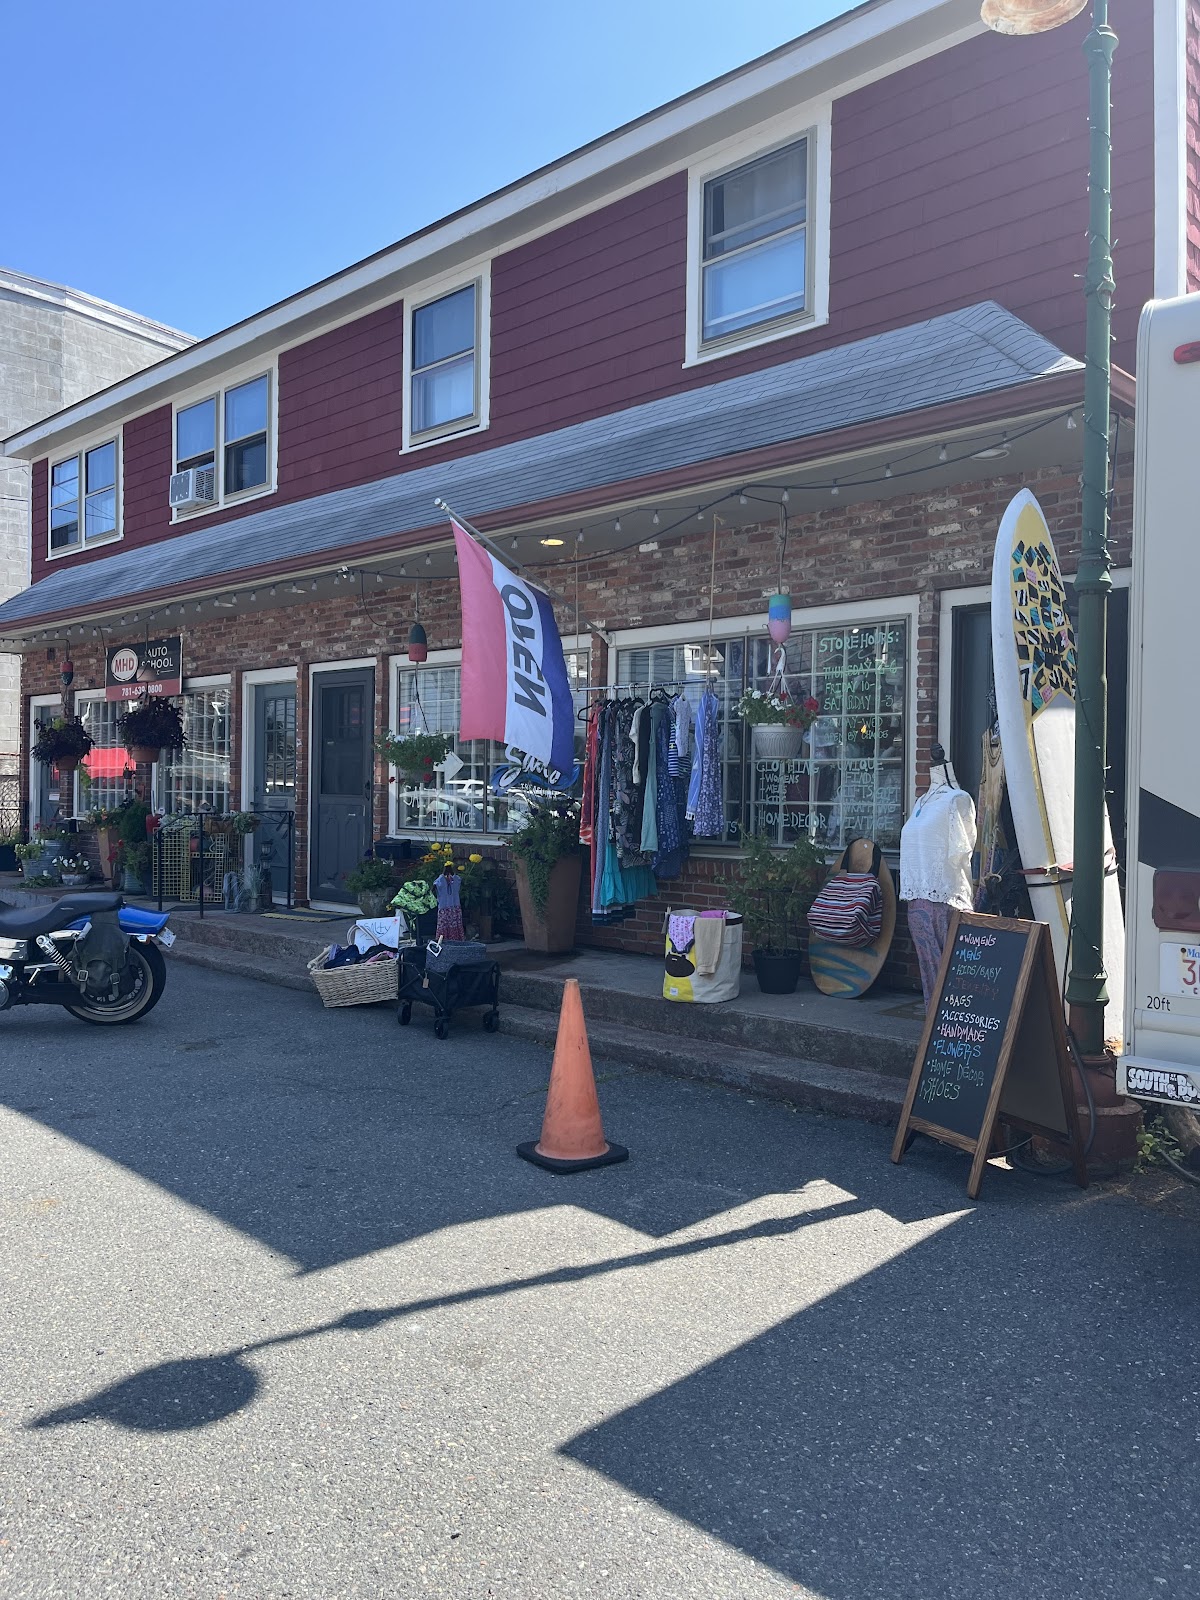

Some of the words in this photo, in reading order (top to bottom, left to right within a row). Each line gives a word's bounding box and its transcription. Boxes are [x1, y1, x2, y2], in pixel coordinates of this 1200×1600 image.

[501, 584, 546, 717] OPEN
[819, 636, 858, 653] STORE
[860, 631, 899, 649] HOURS:
[147, 646, 168, 658] AUTO
[115, 657, 134, 673] MHD
[823, 661, 873, 680] THURSDAY
[825, 682, 858, 695] FRIDAY
[823, 694, 872, 711] SATRDAY
[847, 731, 859, 742] BY
[757, 760, 819, 776] CLOTHING
[837, 758, 884, 771] UNIQUE
[845, 771, 877, 785] FINDS
[431, 806, 476, 828] ENTRANCE
[758, 810, 791, 828] HOME
[790, 811, 827, 829] DECOR
[964, 933, 997, 947] WOMENS
[960, 947, 982, 962] MENS
[956, 964, 1001, 983] KIDS/BABY
[1182, 960, 1200, 986] 3
[949, 994, 973, 1007] BAGS
[1147, 995, 1171, 1012] 20ft
[942, 1009, 1000, 1030] ACCESSORIES
[940, 1023, 987, 1042] HANDMADE
[935, 1040, 981, 1065] FLOWERS
[930, 1059, 954, 1077] HOME
[957, 1063, 985, 1086] DECOR
[1127, 1067, 1169, 1093] SOUTH
[923, 1077, 960, 1103] SHOES
